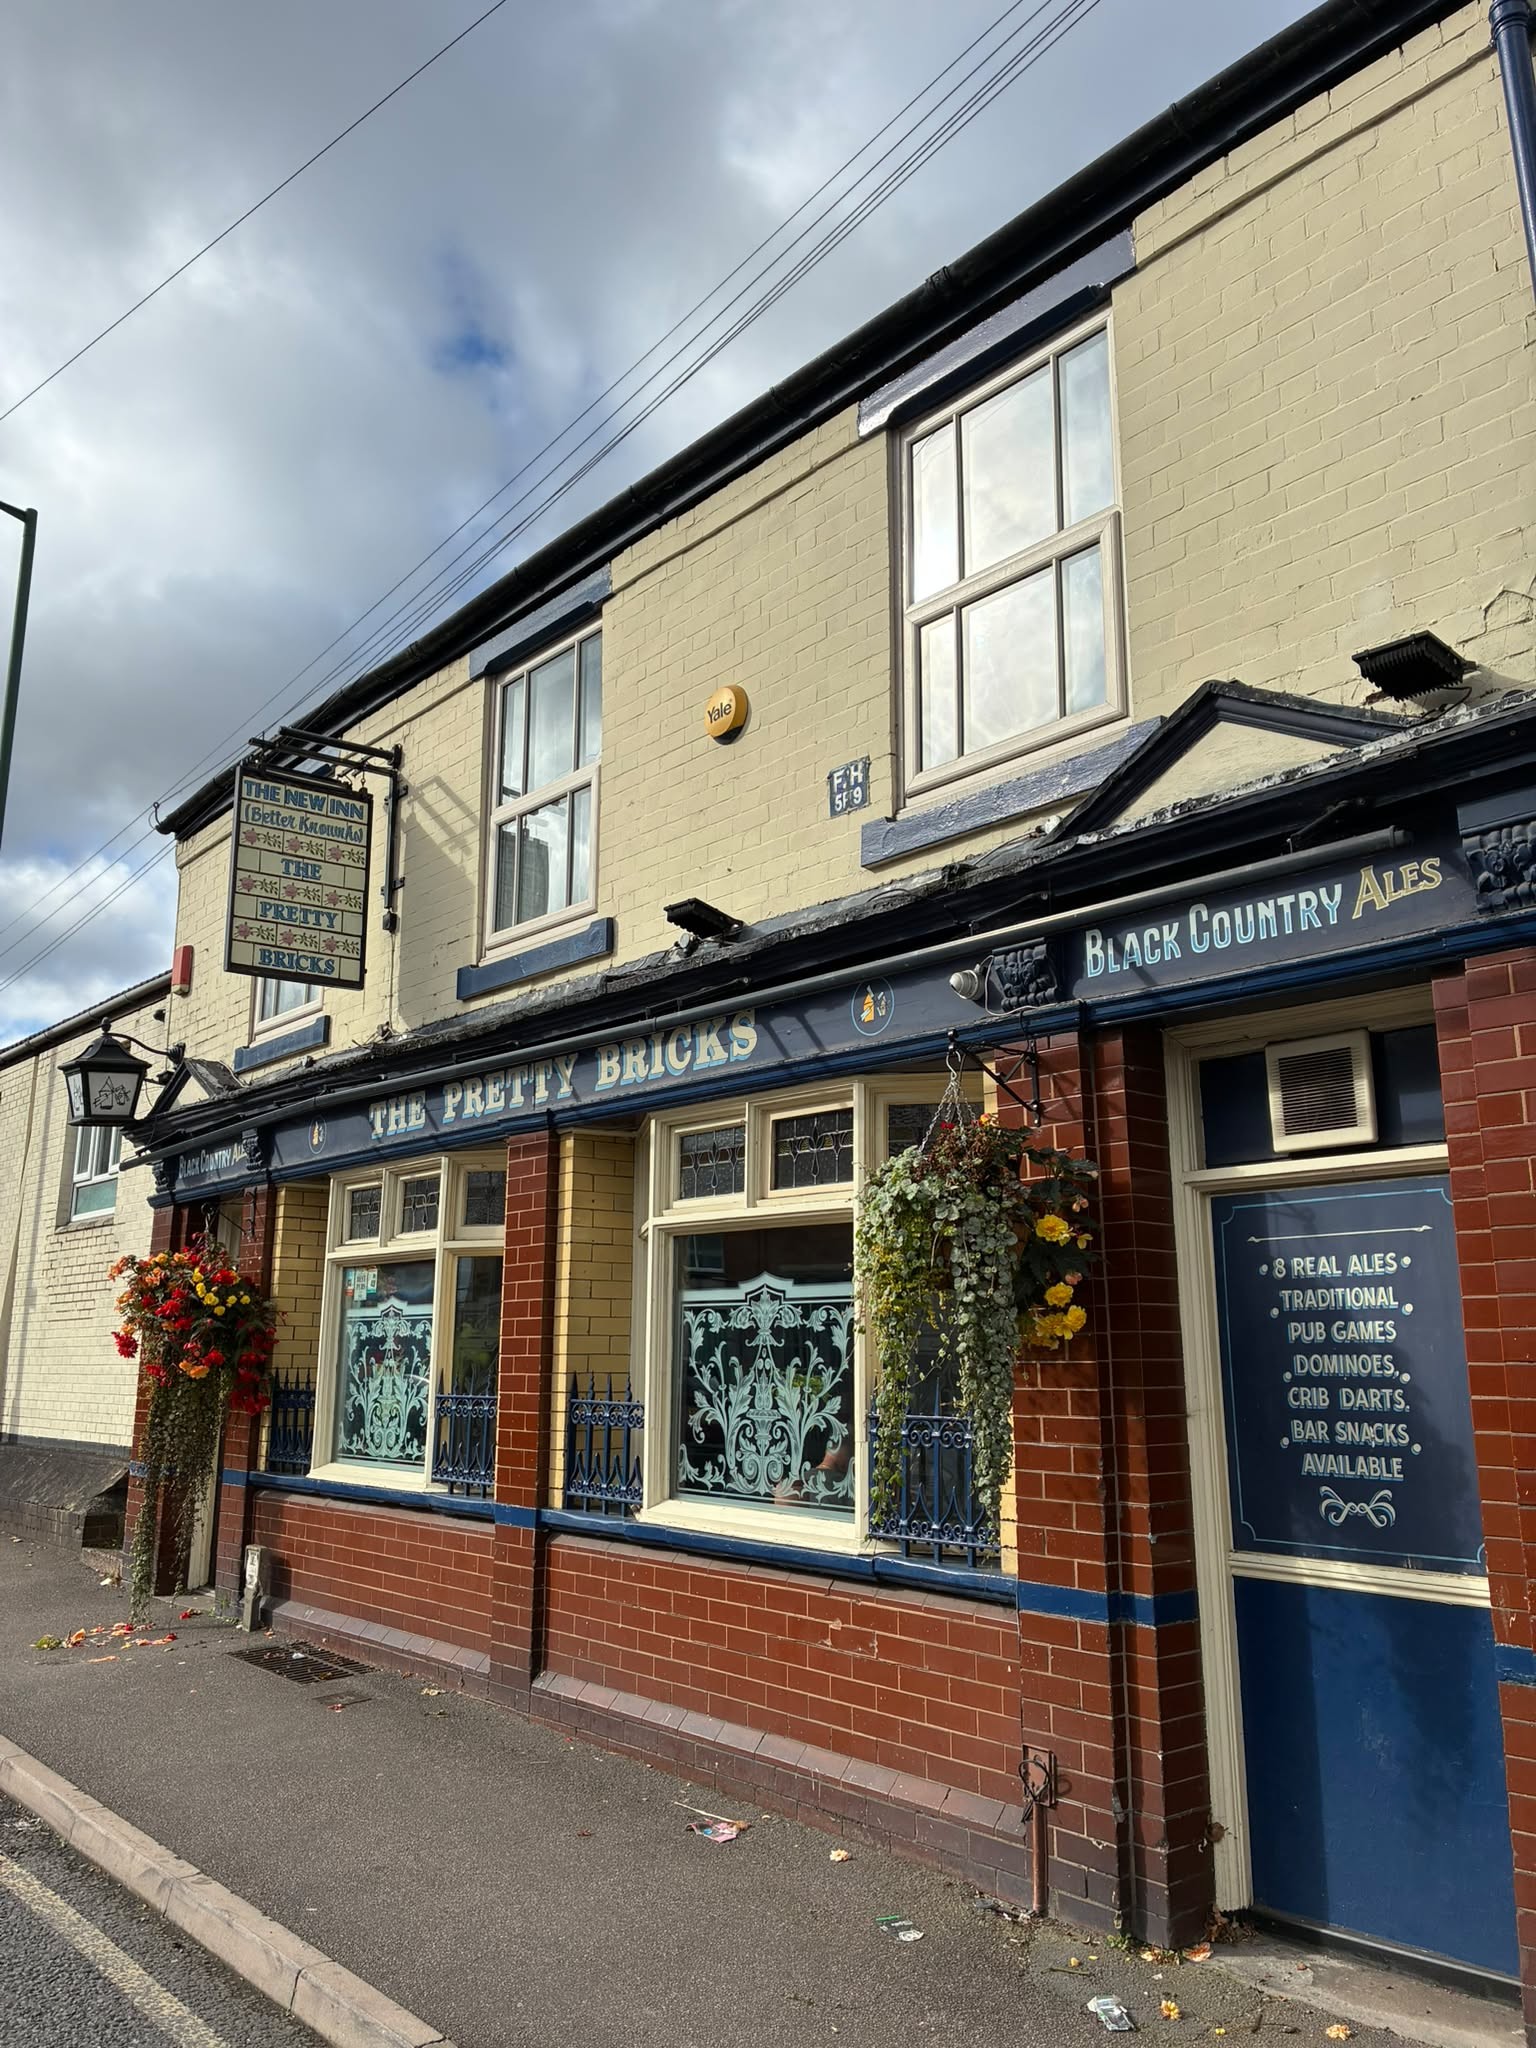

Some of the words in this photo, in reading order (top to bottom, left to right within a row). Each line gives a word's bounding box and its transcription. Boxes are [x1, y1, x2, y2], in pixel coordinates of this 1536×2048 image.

[707, 702, 732, 724] Yale
[244, 780, 281, 802] THE
[285, 789, 326, 812] NEW
[329, 799, 364, 820] INN
[244, 804, 296, 829] (Better
[281, 858, 322, 880] THE
[259, 901, 339, 929] PRETTY
[258, 948, 335, 976] BRICKS
[368, 1091, 426, 1140] THE
[442, 1053, 578, 1124] PRETTY
[594, 1009, 758, 1091] BRICKS
[1272, 1258, 1286, 1280] 8
[1291, 1255, 1342, 1279] REAL
[1347, 1252, 1398, 1277] ALES
[1280, 1286, 1399, 1311] TRADITIONAL
[1288, 1321, 1326, 1343] PUB
[1331, 1320, 1397, 1343] GAMES
[1293, 1354, 1400, 1379] DOMINOES,
[1287, 1387, 1330, 1410] CRIB
[1291, 1419, 1330, 1443] BAR
[1335, 1421, 1410, 1446] SNACKS
[1301, 1453, 1404, 1482] AVAILABLE
